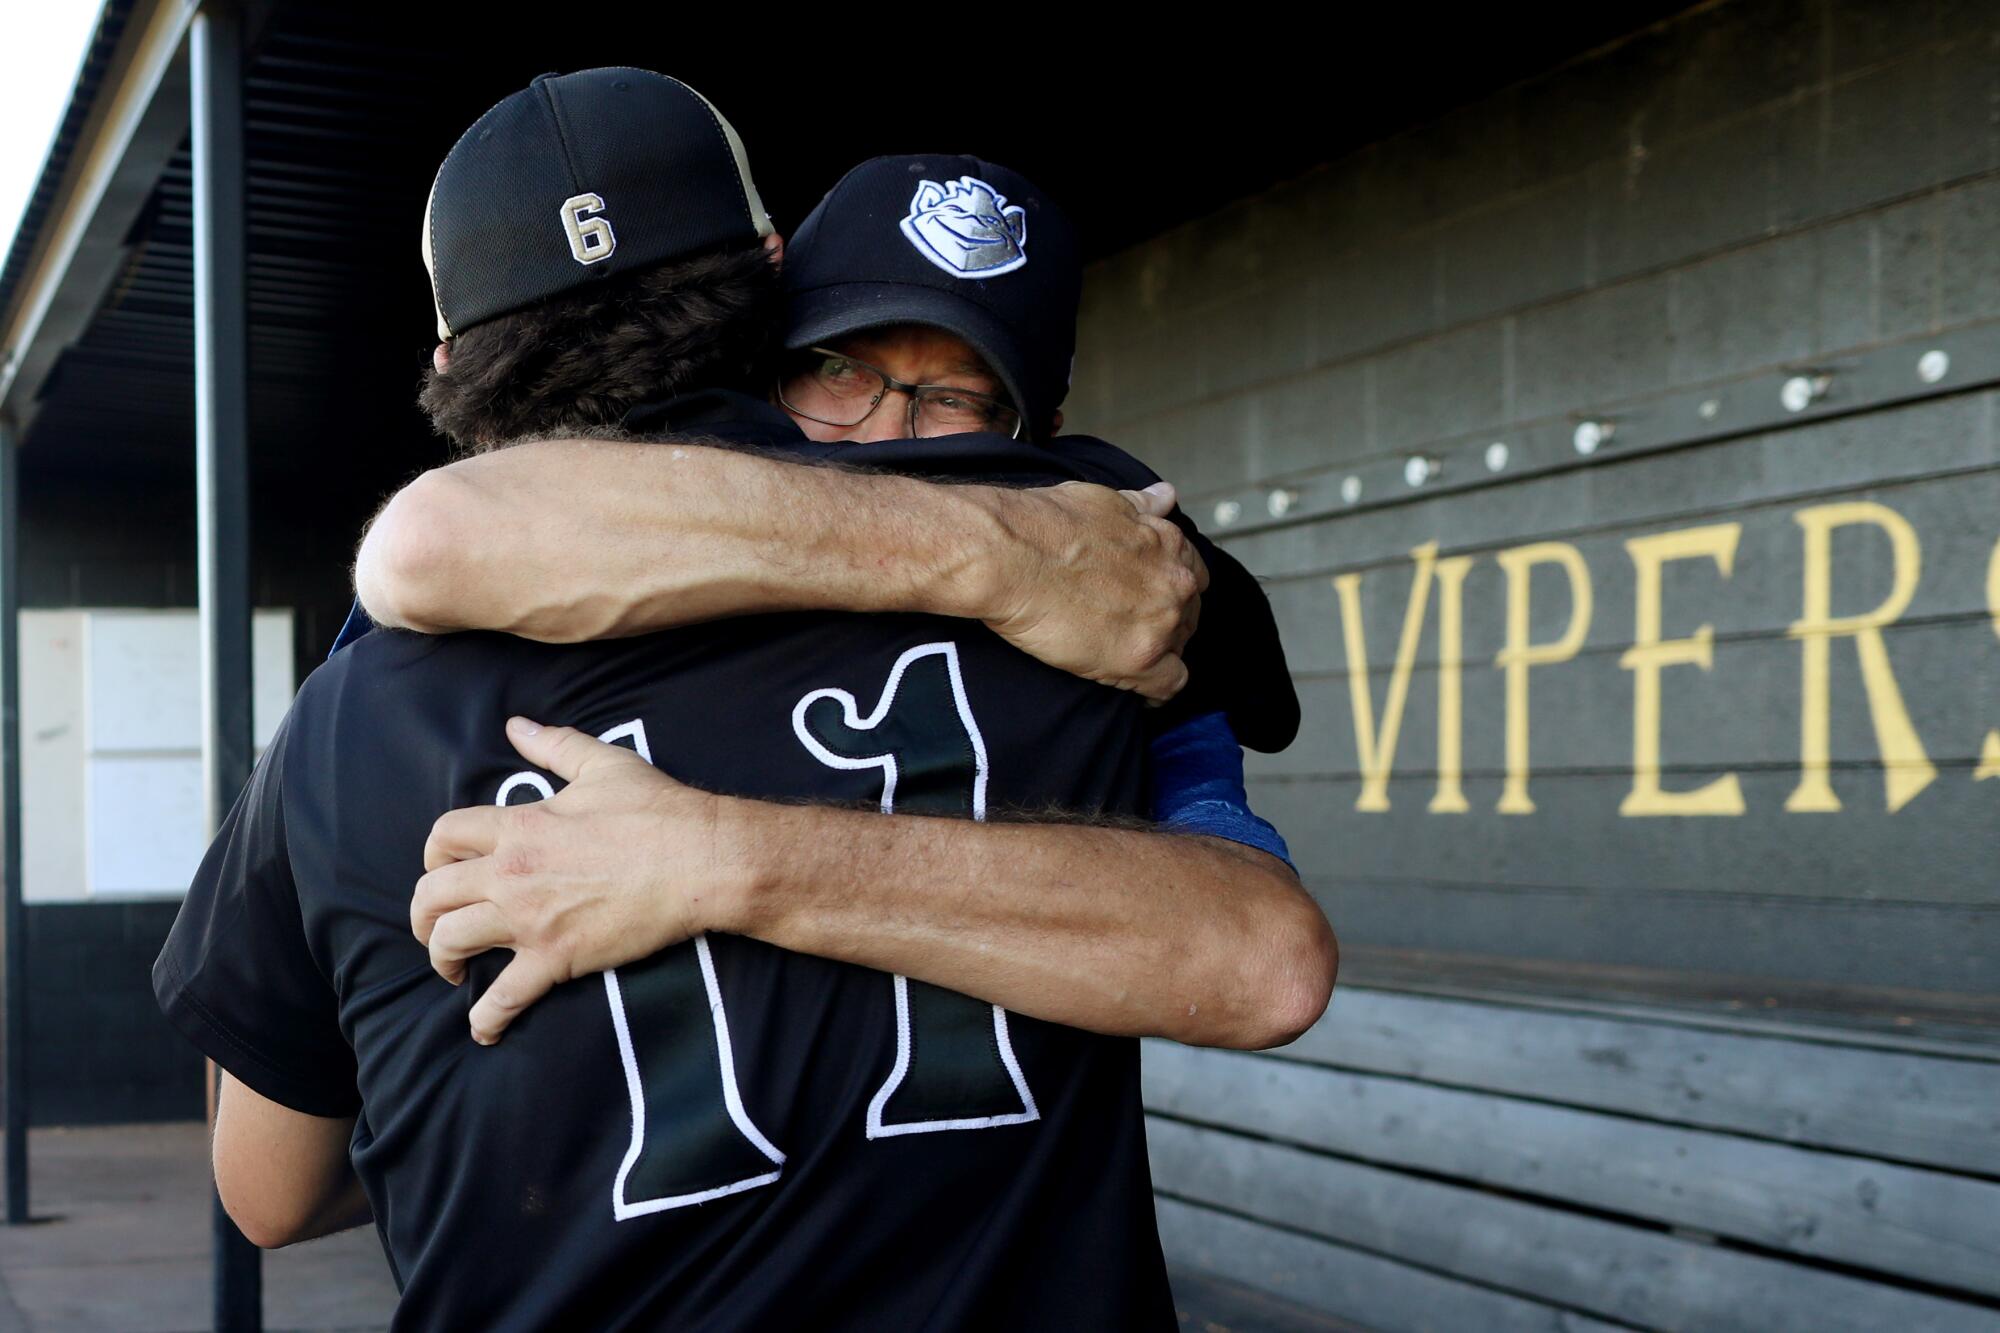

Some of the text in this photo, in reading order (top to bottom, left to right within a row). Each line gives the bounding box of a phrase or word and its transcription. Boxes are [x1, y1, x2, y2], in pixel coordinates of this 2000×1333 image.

[560, 192, 616, 265] 6
[1334, 501, 2000, 816] VIPER
[495, 641, 1040, 1221] 11
